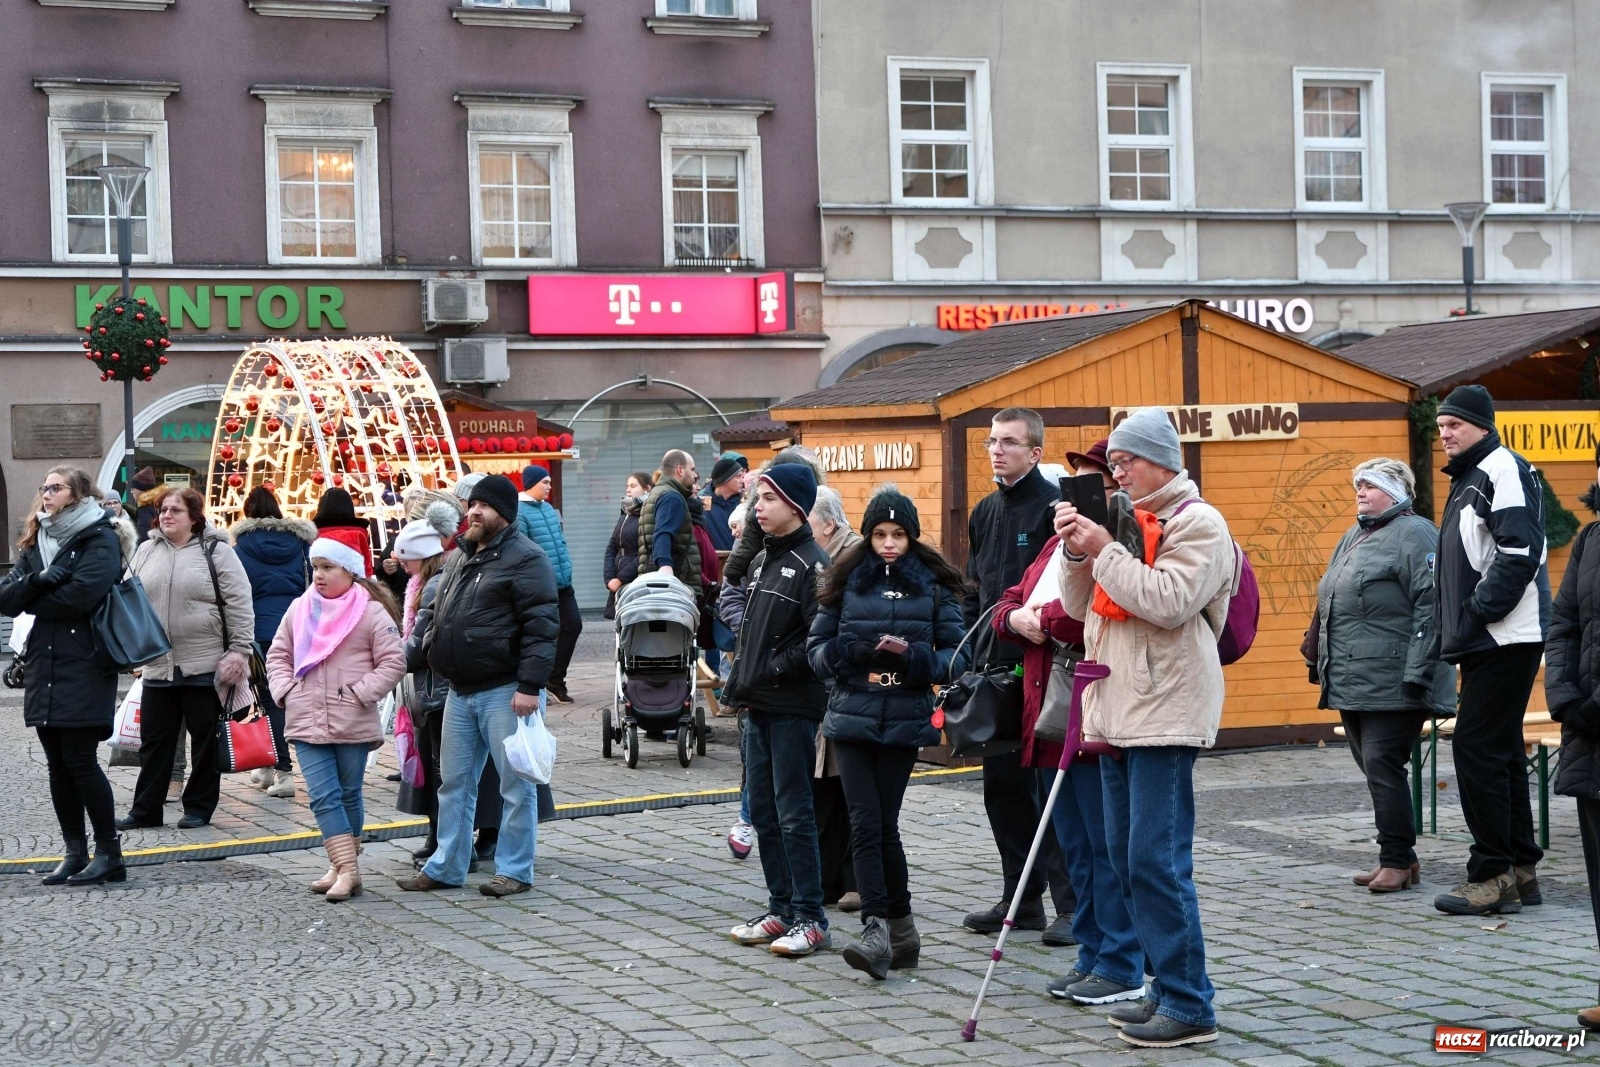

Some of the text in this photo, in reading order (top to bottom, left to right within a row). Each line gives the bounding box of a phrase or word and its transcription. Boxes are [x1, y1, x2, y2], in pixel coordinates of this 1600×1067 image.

[459, 419, 525, 434] PODHALA
[1227, 405, 1298, 437] WINO
[873, 441, 914, 470] WINO
